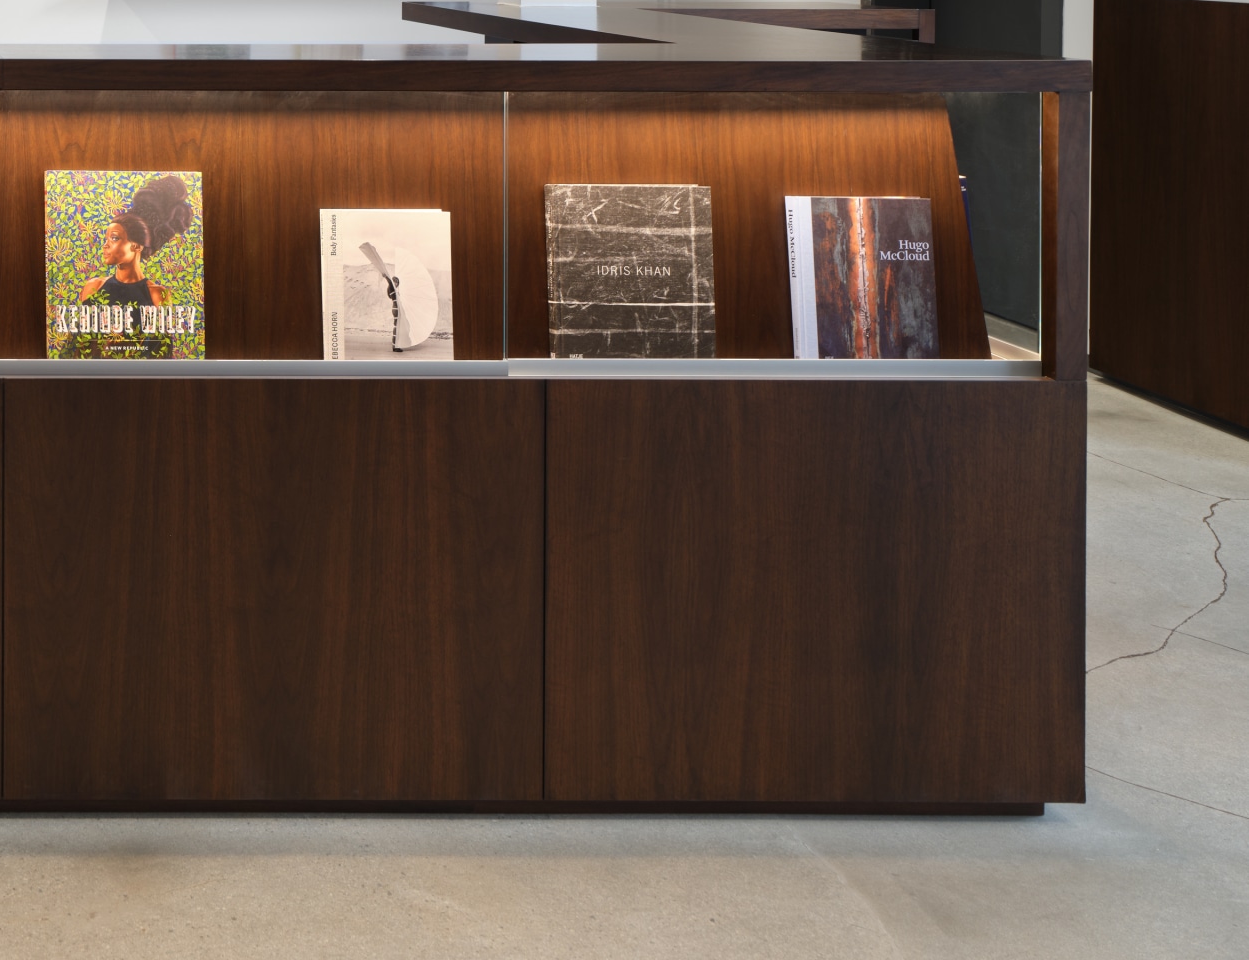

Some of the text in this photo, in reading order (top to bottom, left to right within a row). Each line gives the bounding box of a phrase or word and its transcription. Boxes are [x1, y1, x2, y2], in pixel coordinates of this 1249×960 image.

[330, 241, 338, 256] Body
[898, 239, 930, 252] Hugo
[879, 250, 930, 261] McCloud
[597, 265, 671, 276] IDRIS KHAN
[55, 304, 197, 334] KEHINDE WILEY
[331, 332, 339, 360] EBECCA
